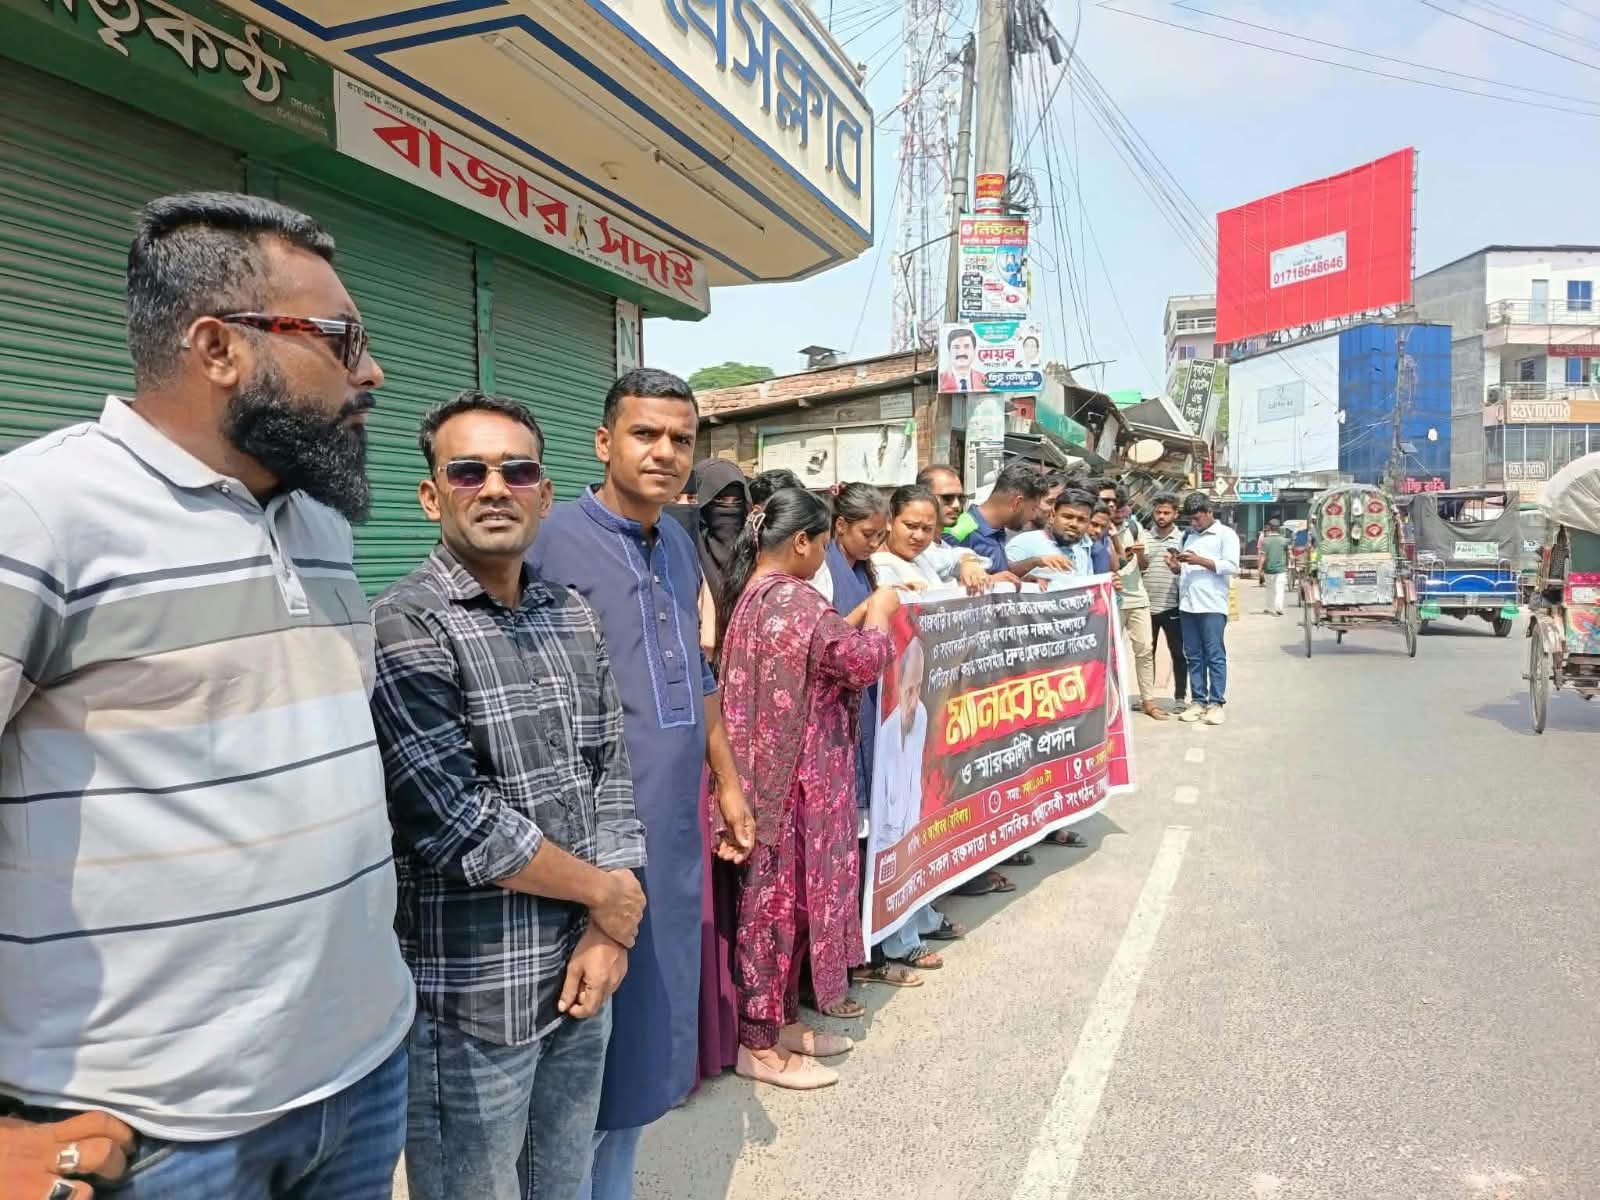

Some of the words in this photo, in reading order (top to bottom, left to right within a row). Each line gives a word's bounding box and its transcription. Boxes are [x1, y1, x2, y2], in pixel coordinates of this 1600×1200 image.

[46, 0, 288, 102] তৃকণ্ঠ
[365, 102, 568, 236] বাজার
[594, 216, 699, 301] সদাই
[1273, 256, 1344, 284] 01716648646
[978, 348, 1016, 361] মেয়র
[945, 666, 1087, 745] মানববন্ধন
[961, 765, 973, 785] ও
[975, 734, 1034, 778] স্মারকলিপি
[1037, 726, 1076, 754] প্রদান
[928, 852, 950, 877] সকল
[951, 833, 988, 864] রক্তদাতা
[998, 813, 1029, 840] মানবিক
